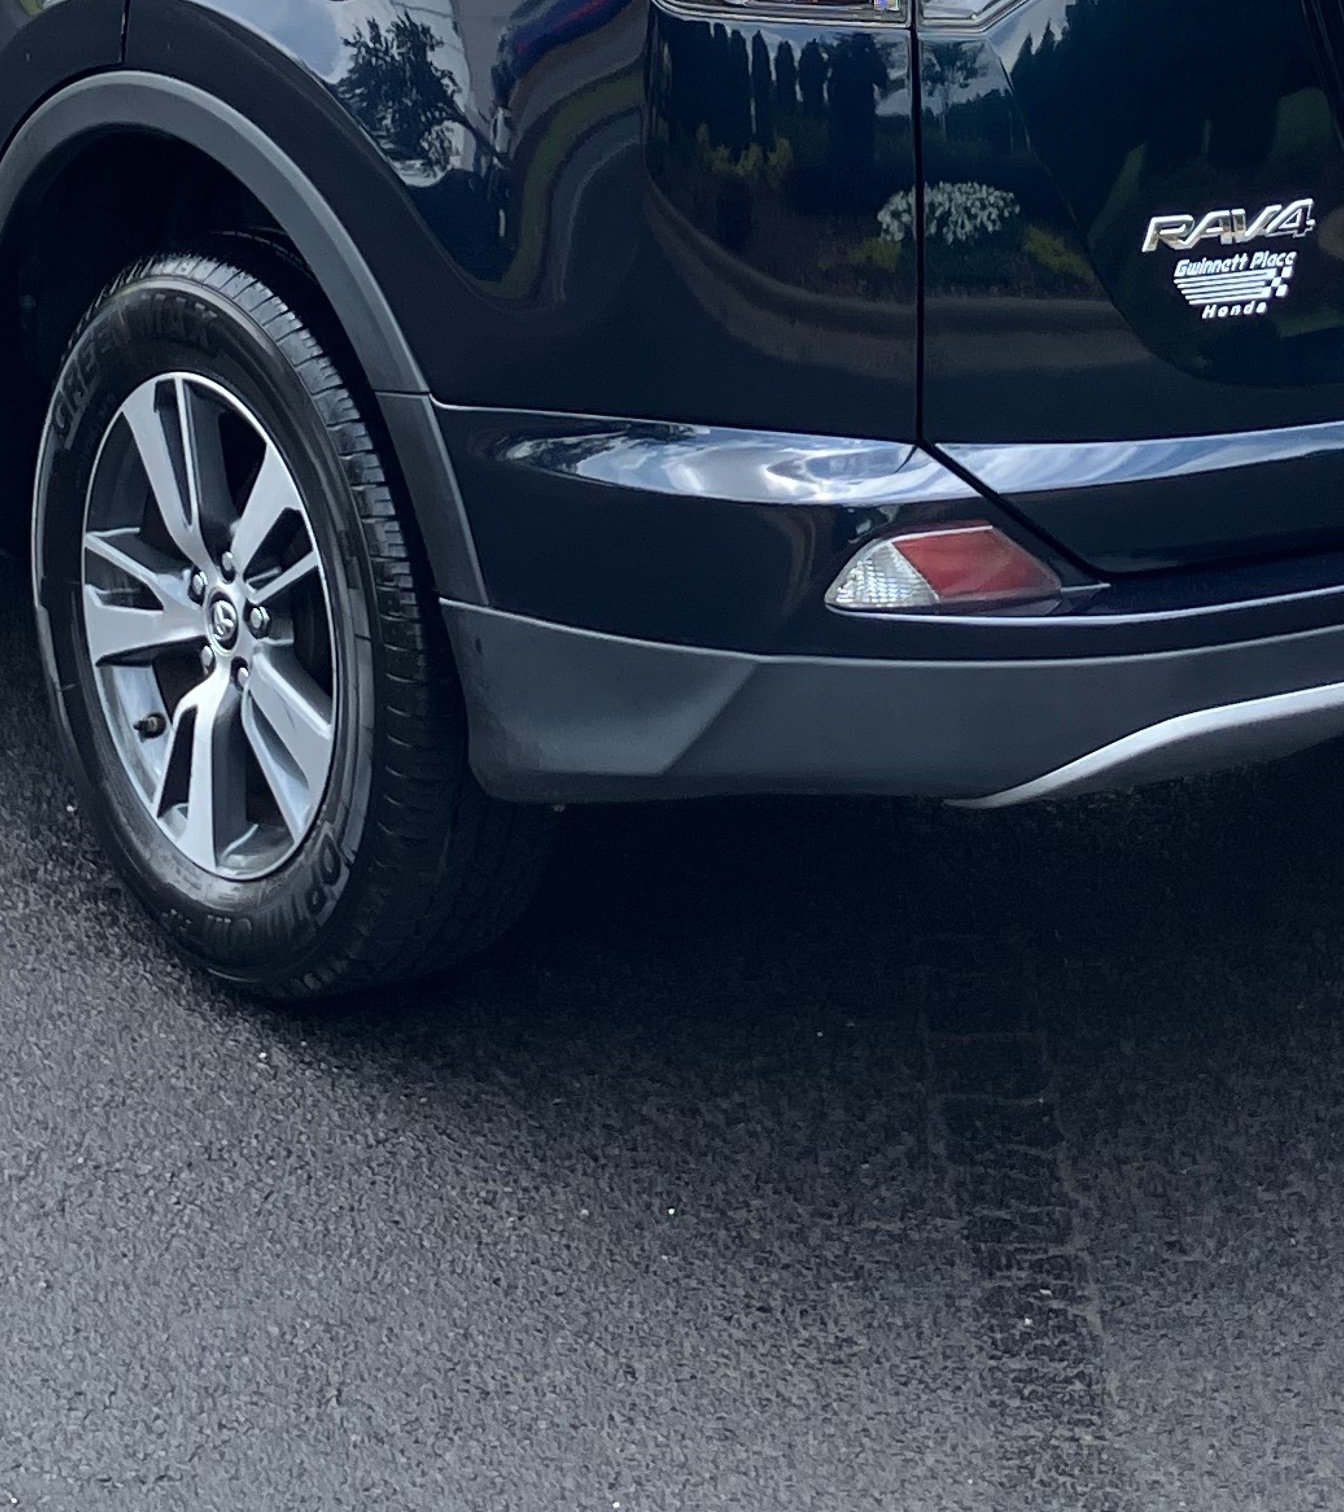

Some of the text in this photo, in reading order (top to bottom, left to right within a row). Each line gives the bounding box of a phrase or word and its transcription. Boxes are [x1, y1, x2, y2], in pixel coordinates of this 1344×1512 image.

[1141, 198, 1316, 252] RAV4
[1173, 250, 1298, 277] Gwinnett Place
[1202, 301, 1268, 319] Honda
